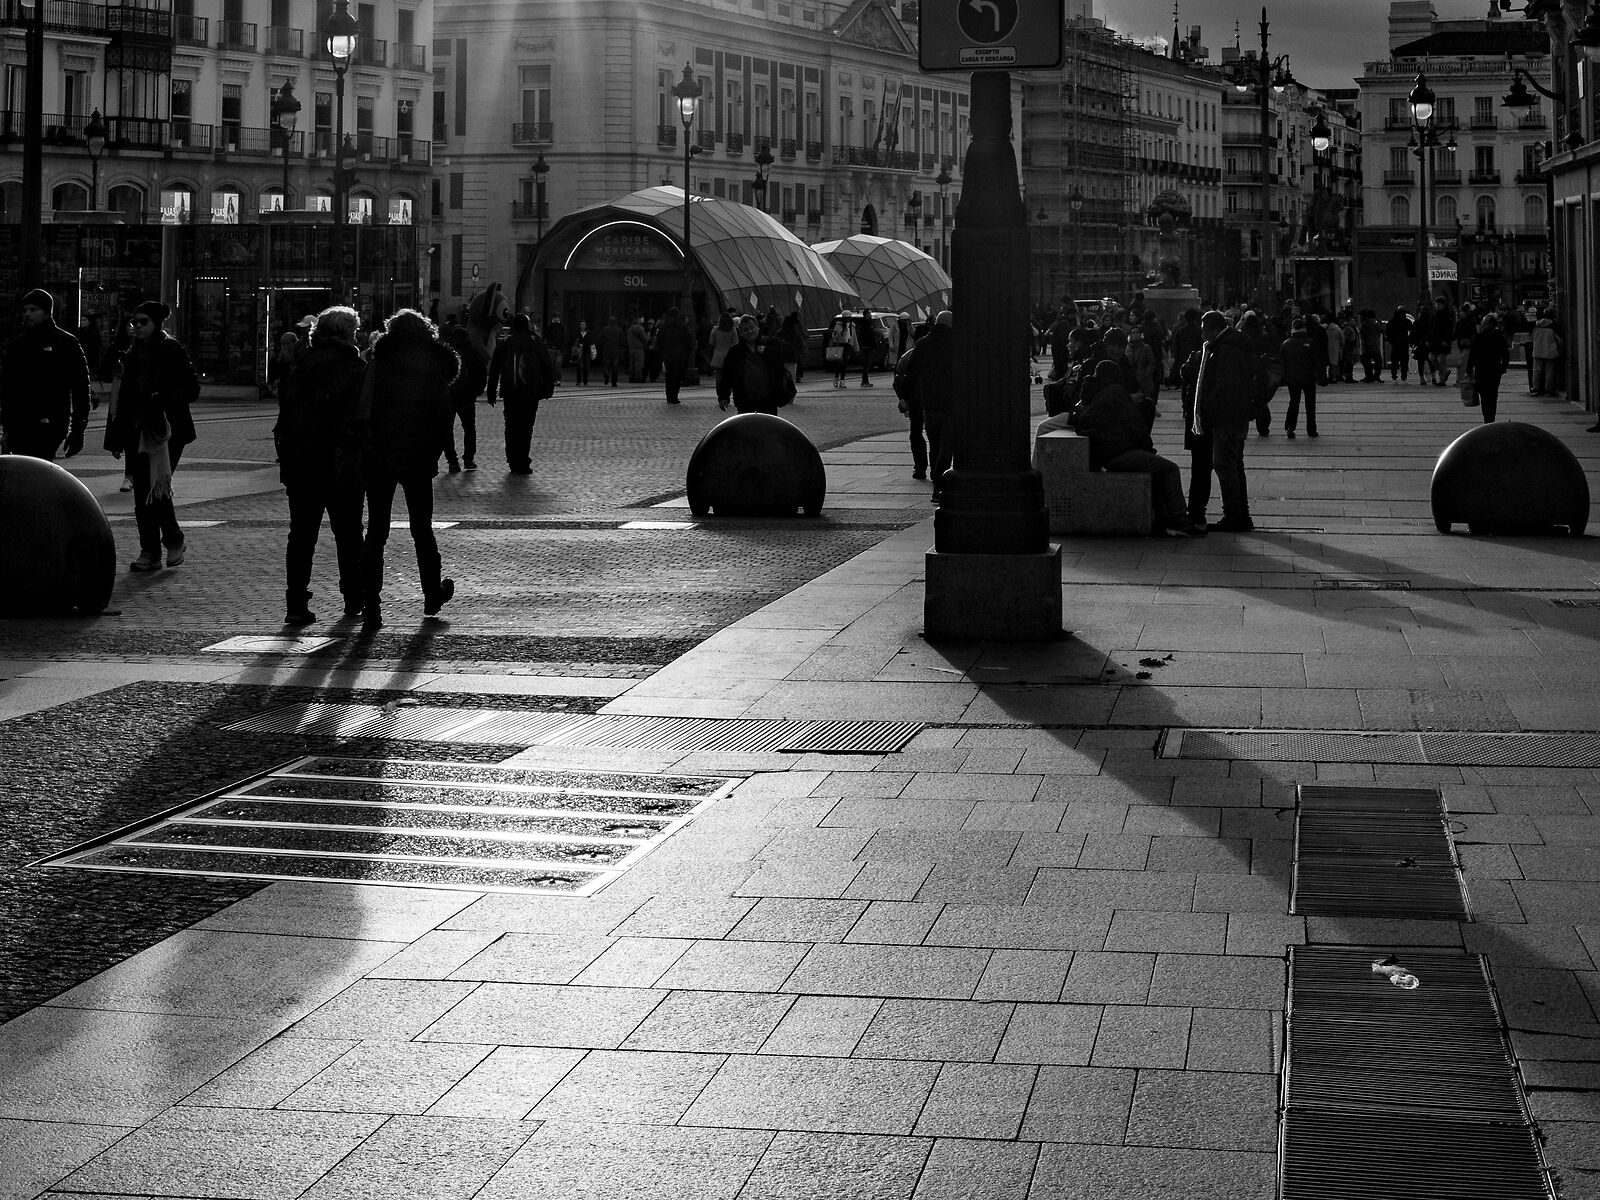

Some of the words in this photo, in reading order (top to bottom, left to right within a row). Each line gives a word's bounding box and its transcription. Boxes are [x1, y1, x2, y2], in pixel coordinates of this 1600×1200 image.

[217, 231, 250, 240] MADRID
[604, 236, 649, 245] CARIBE
[595, 246, 658, 256] MEXICANO
[624, 275, 647, 286] SOL
